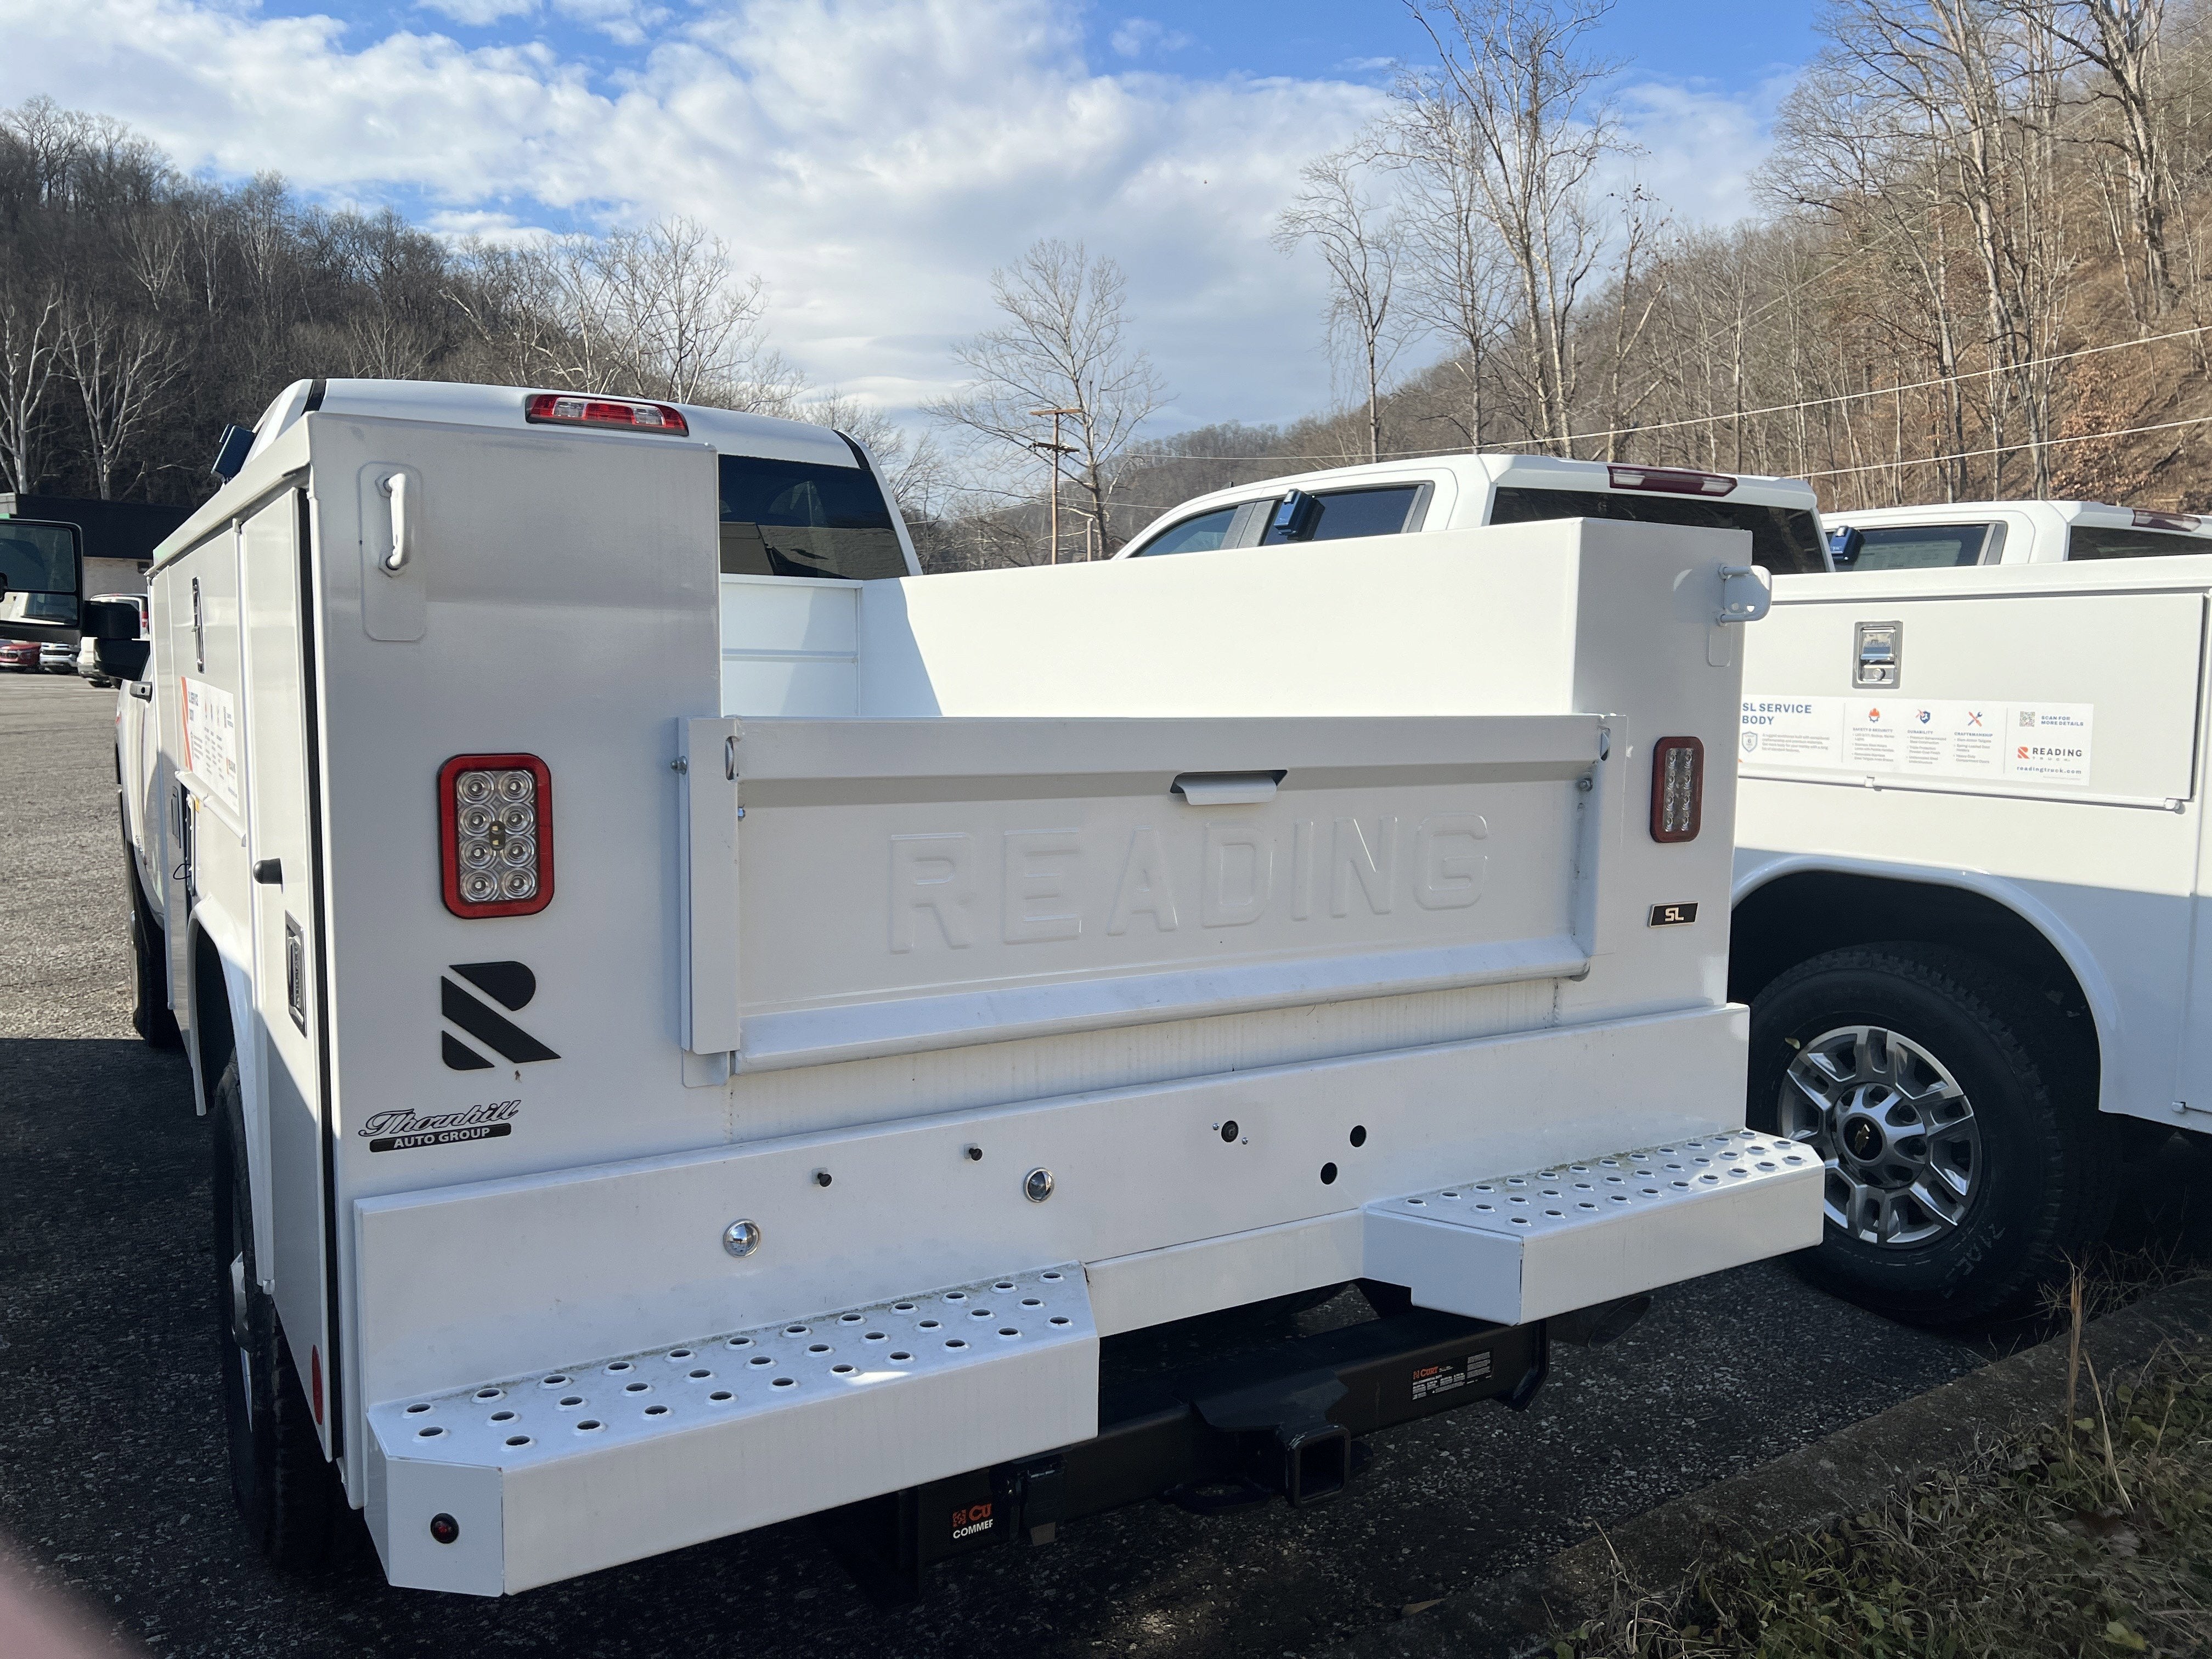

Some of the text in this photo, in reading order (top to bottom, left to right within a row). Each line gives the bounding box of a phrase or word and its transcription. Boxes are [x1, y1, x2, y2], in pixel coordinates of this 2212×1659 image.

[1742, 703, 1812, 714] SL SERVICE
[1742, 715, 1774, 725] BODY
[2032, 747, 2083, 757] READING
[2017, 766, 2082, 774] readingtruck.com
[889, 813, 1488, 953] READING
[1664, 907, 1684, 922] SL
[358, 1099, 521, 1137] Thornhill
[393, 1127, 490, 1148] AUTO GROUP
